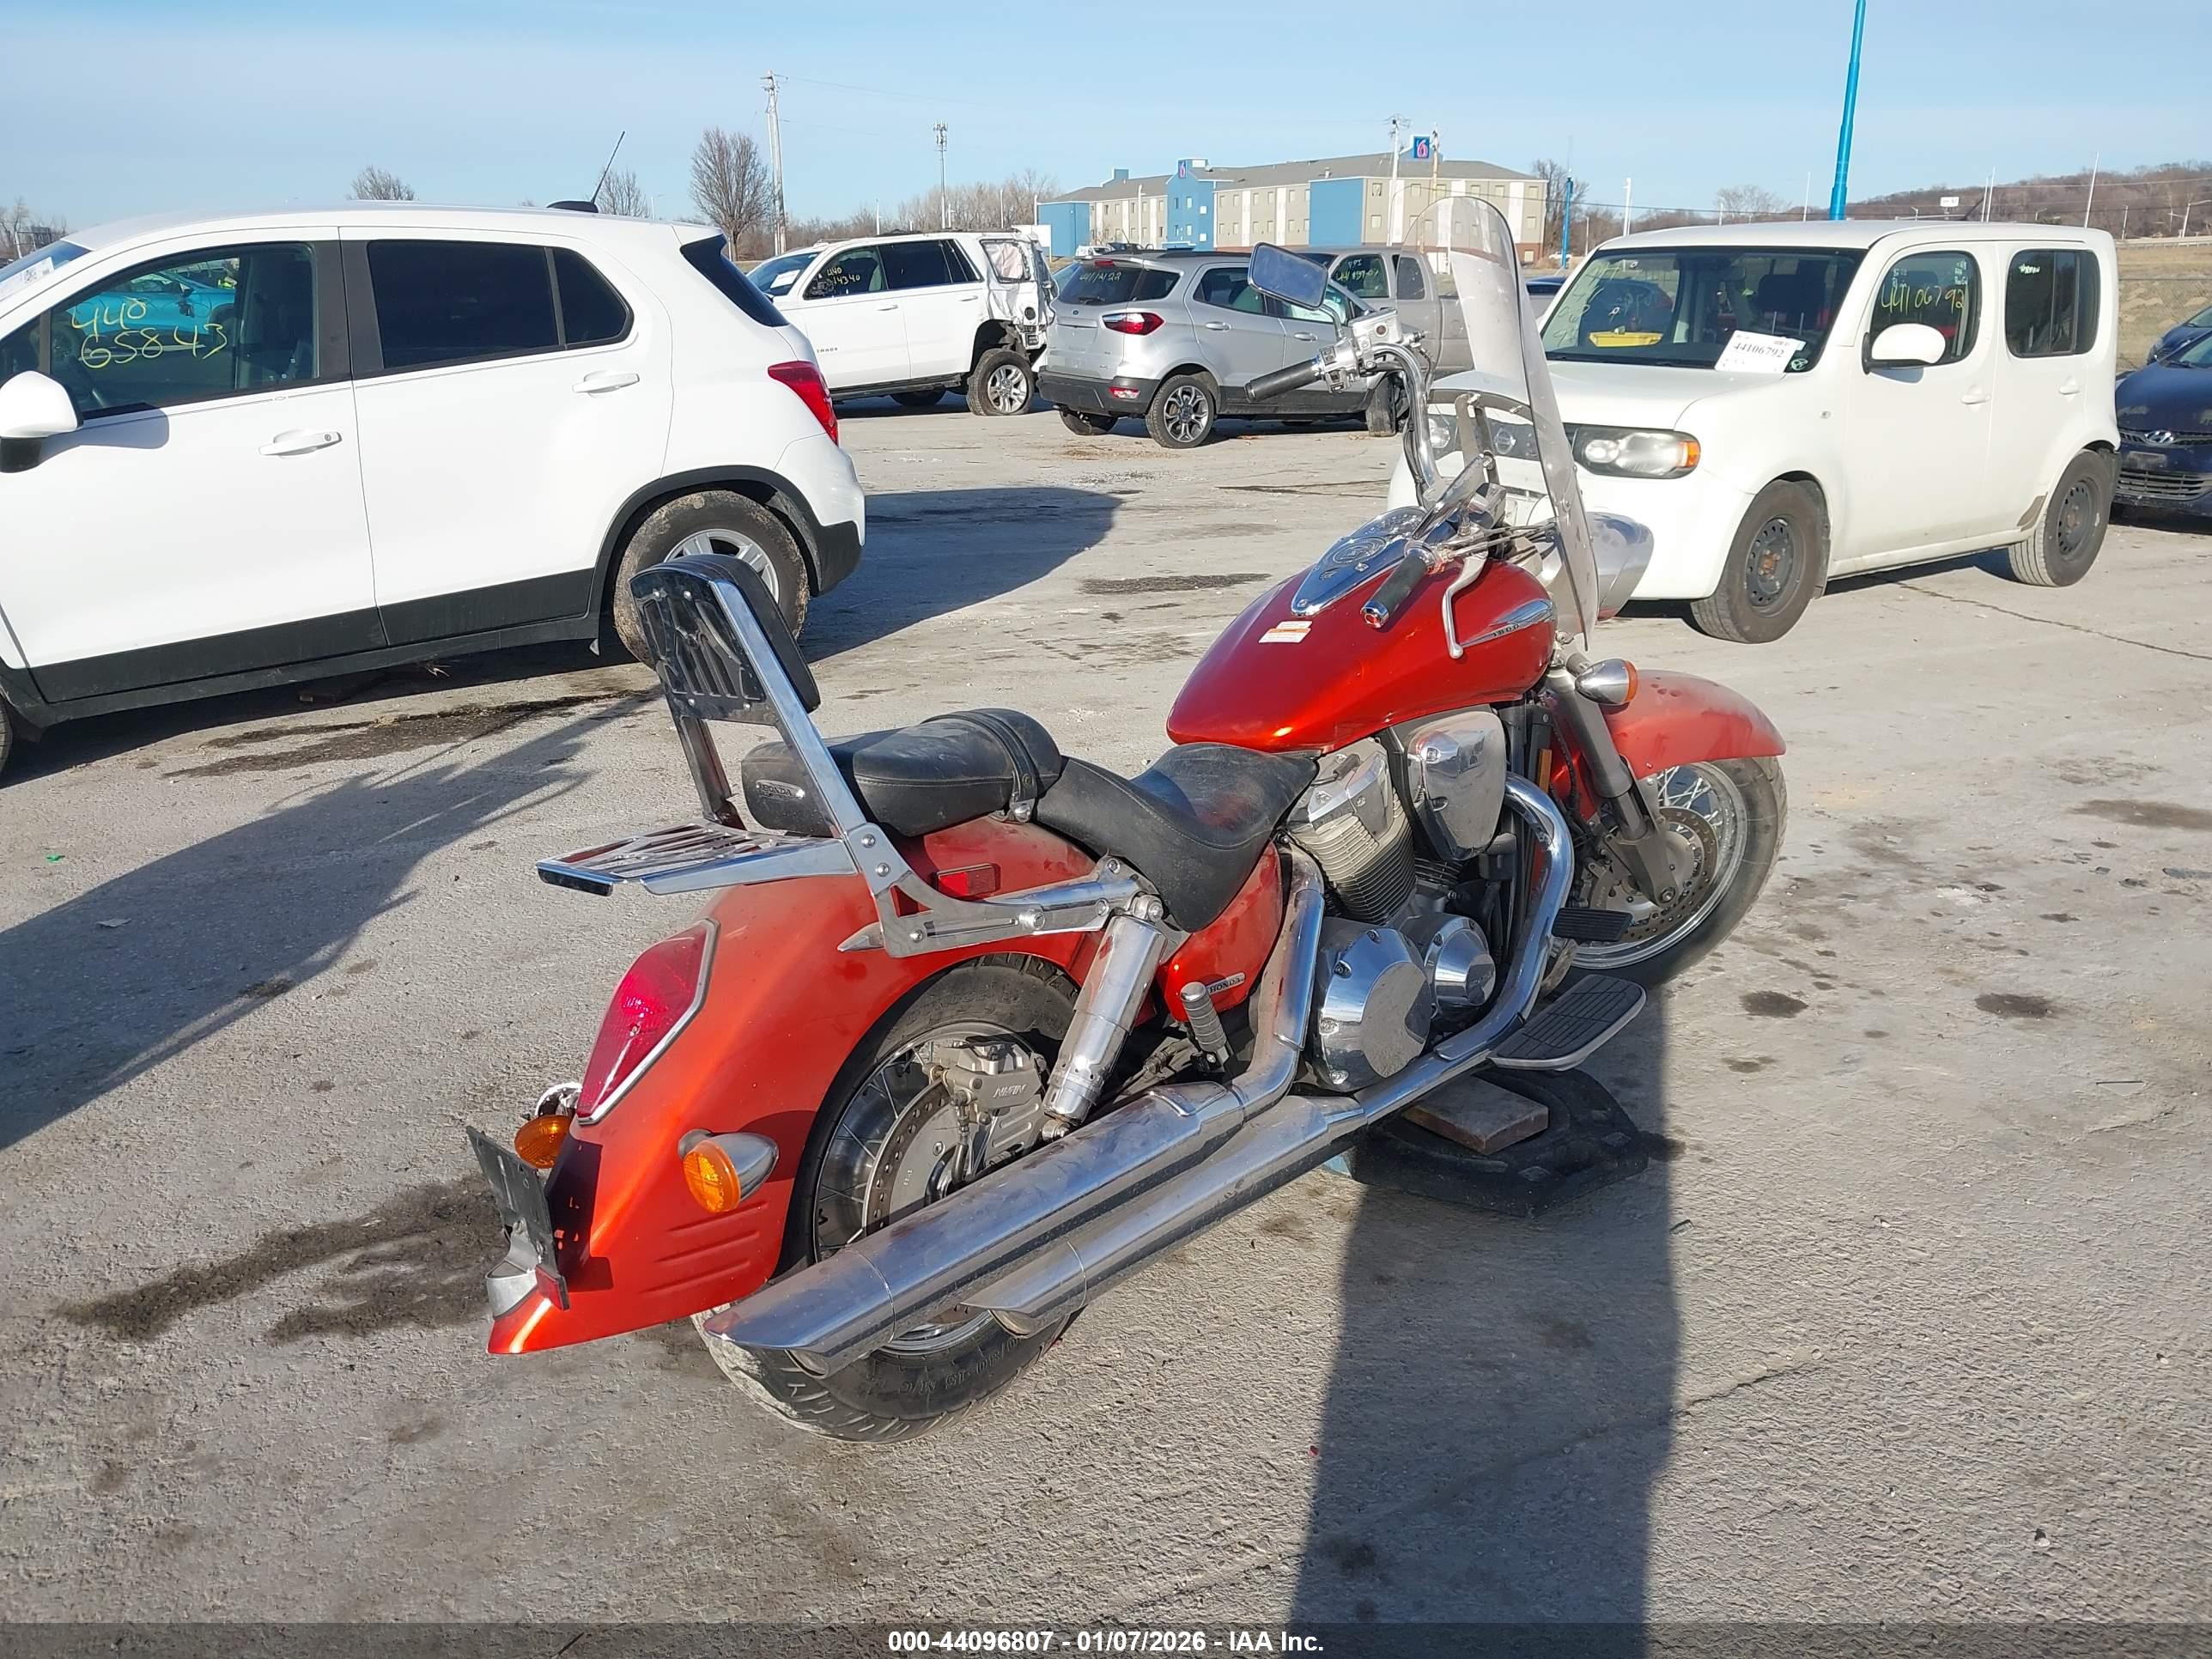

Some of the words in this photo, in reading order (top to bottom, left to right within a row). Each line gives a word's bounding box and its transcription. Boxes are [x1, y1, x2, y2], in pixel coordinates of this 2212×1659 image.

[1417, 138, 1429, 159] 6
[833, 274, 860, 285] 14340
[71, 295, 148, 343] 440
[81, 323, 228, 368] 65843
[1733, 343, 1785, 358] 44106792
[759, 783, 793, 797] HONDA
